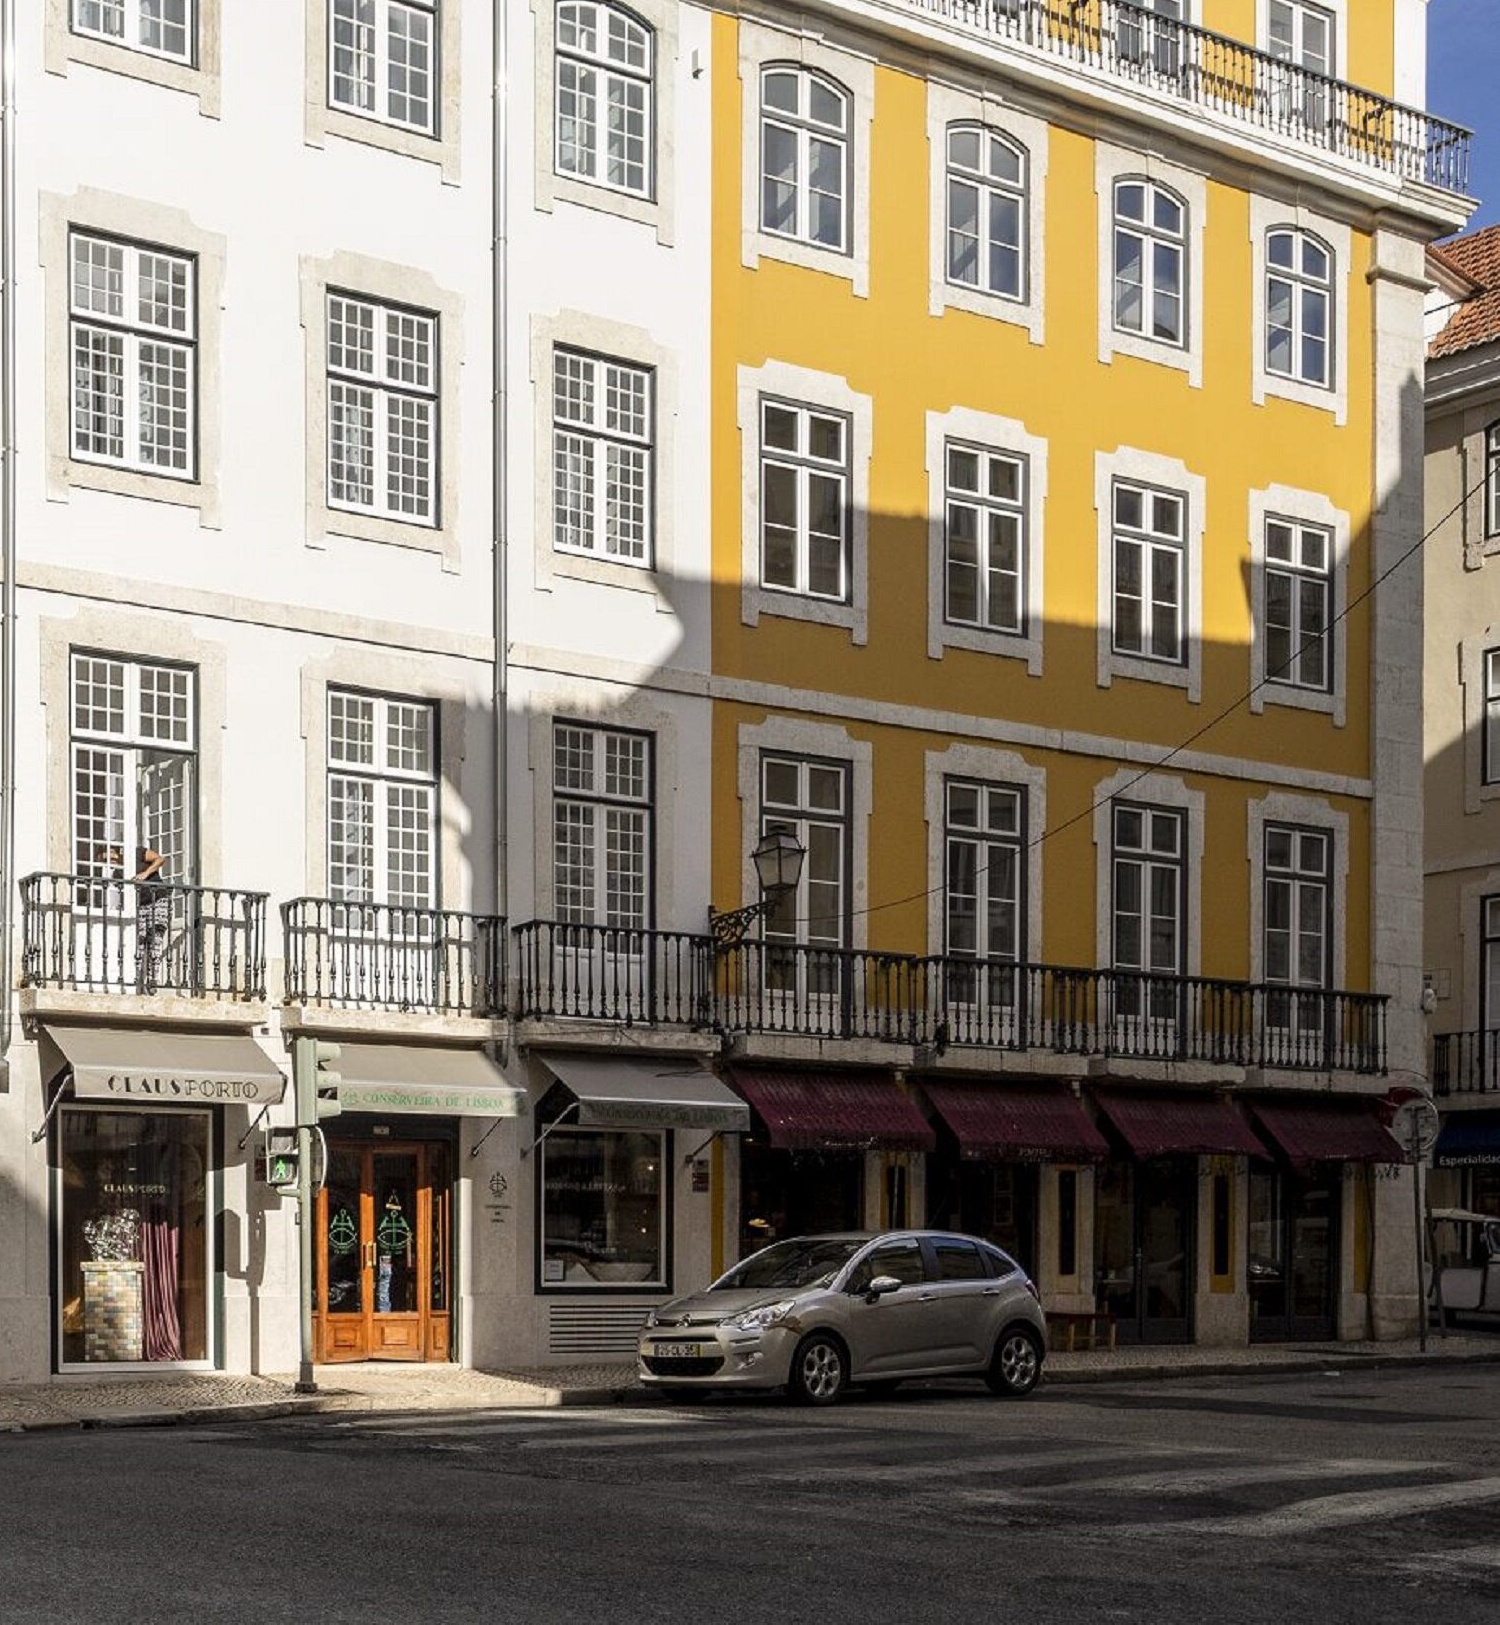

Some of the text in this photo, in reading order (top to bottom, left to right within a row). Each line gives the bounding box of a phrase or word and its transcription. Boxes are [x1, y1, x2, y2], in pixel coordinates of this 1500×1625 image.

[107, 1074, 259, 1100] CLAUS PORTO
[362, 1093, 504, 1110] CONSERVEIRA DE LISBOA
[104, 1183, 134, 1193] CLAUS
